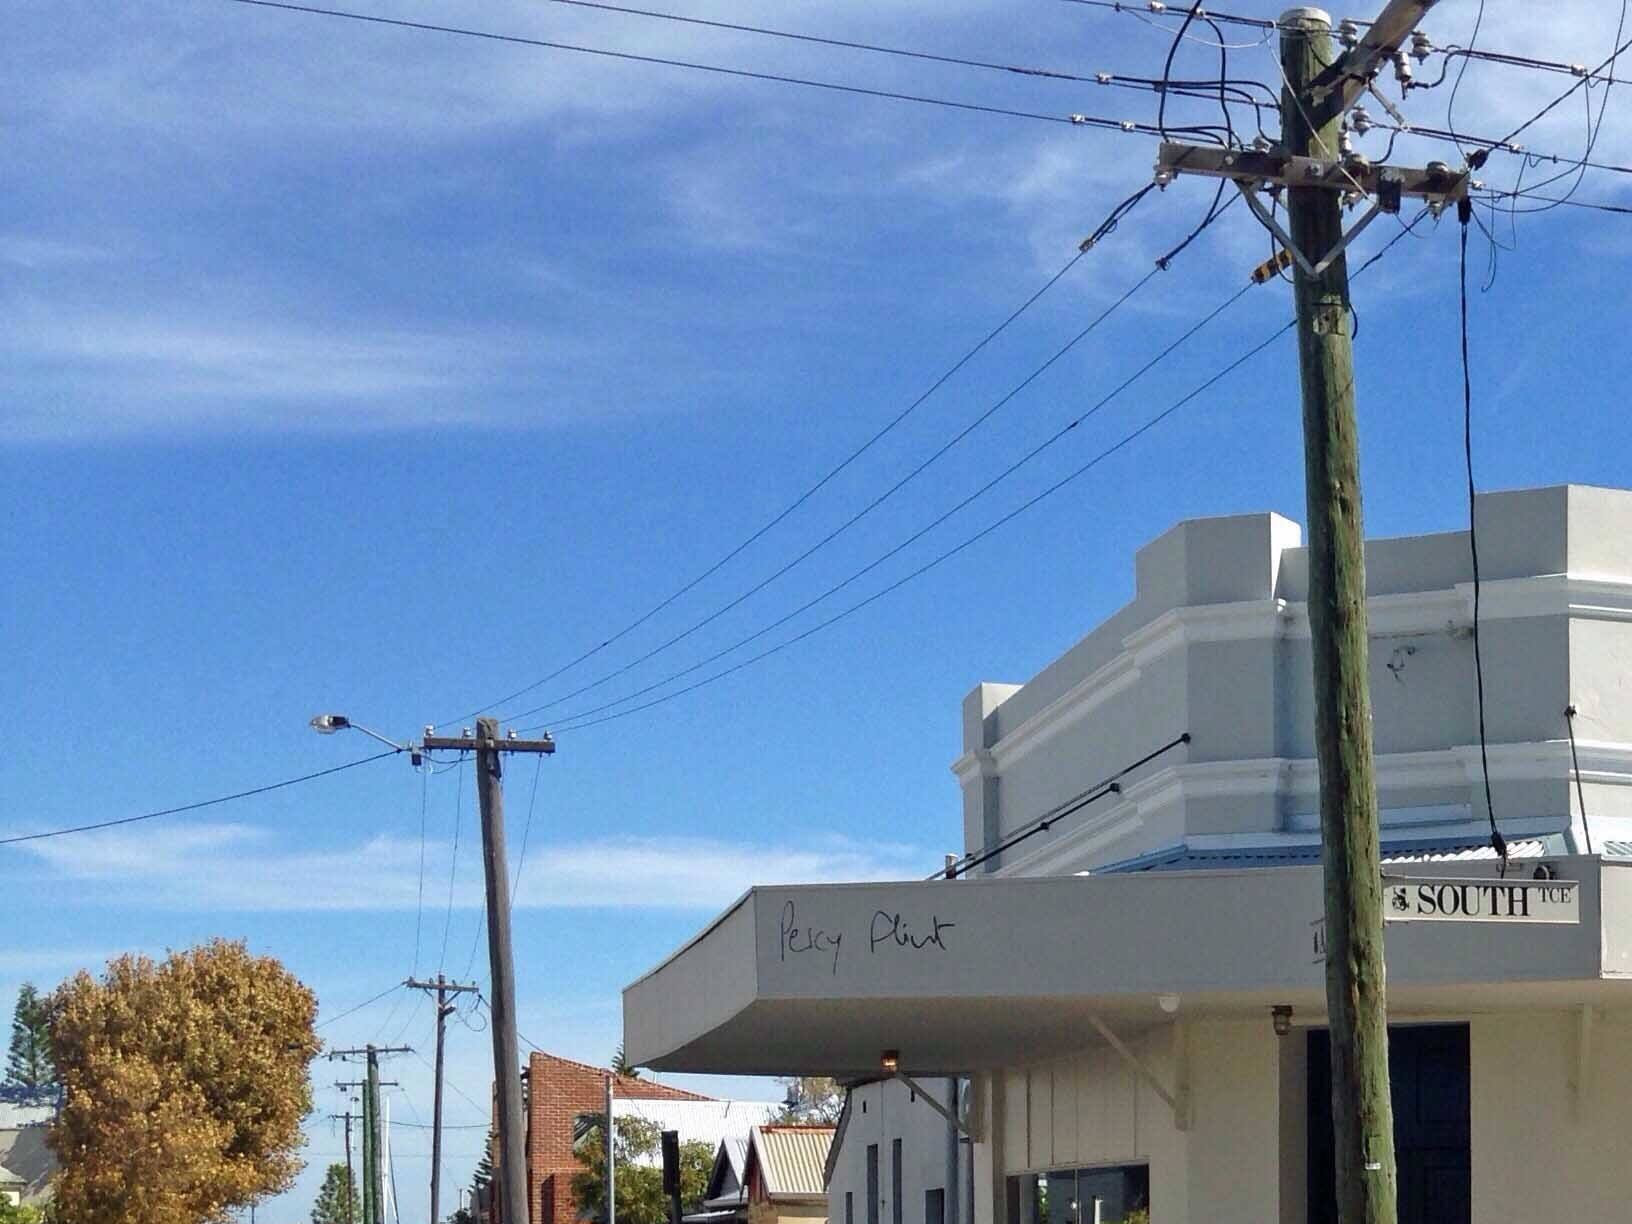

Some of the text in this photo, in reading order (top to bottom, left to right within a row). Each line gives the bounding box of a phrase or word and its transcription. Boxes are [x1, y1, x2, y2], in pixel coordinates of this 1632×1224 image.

[1417, 884, 1571, 917] SOUTH TCE
[780, 900, 842, 976] Percy
